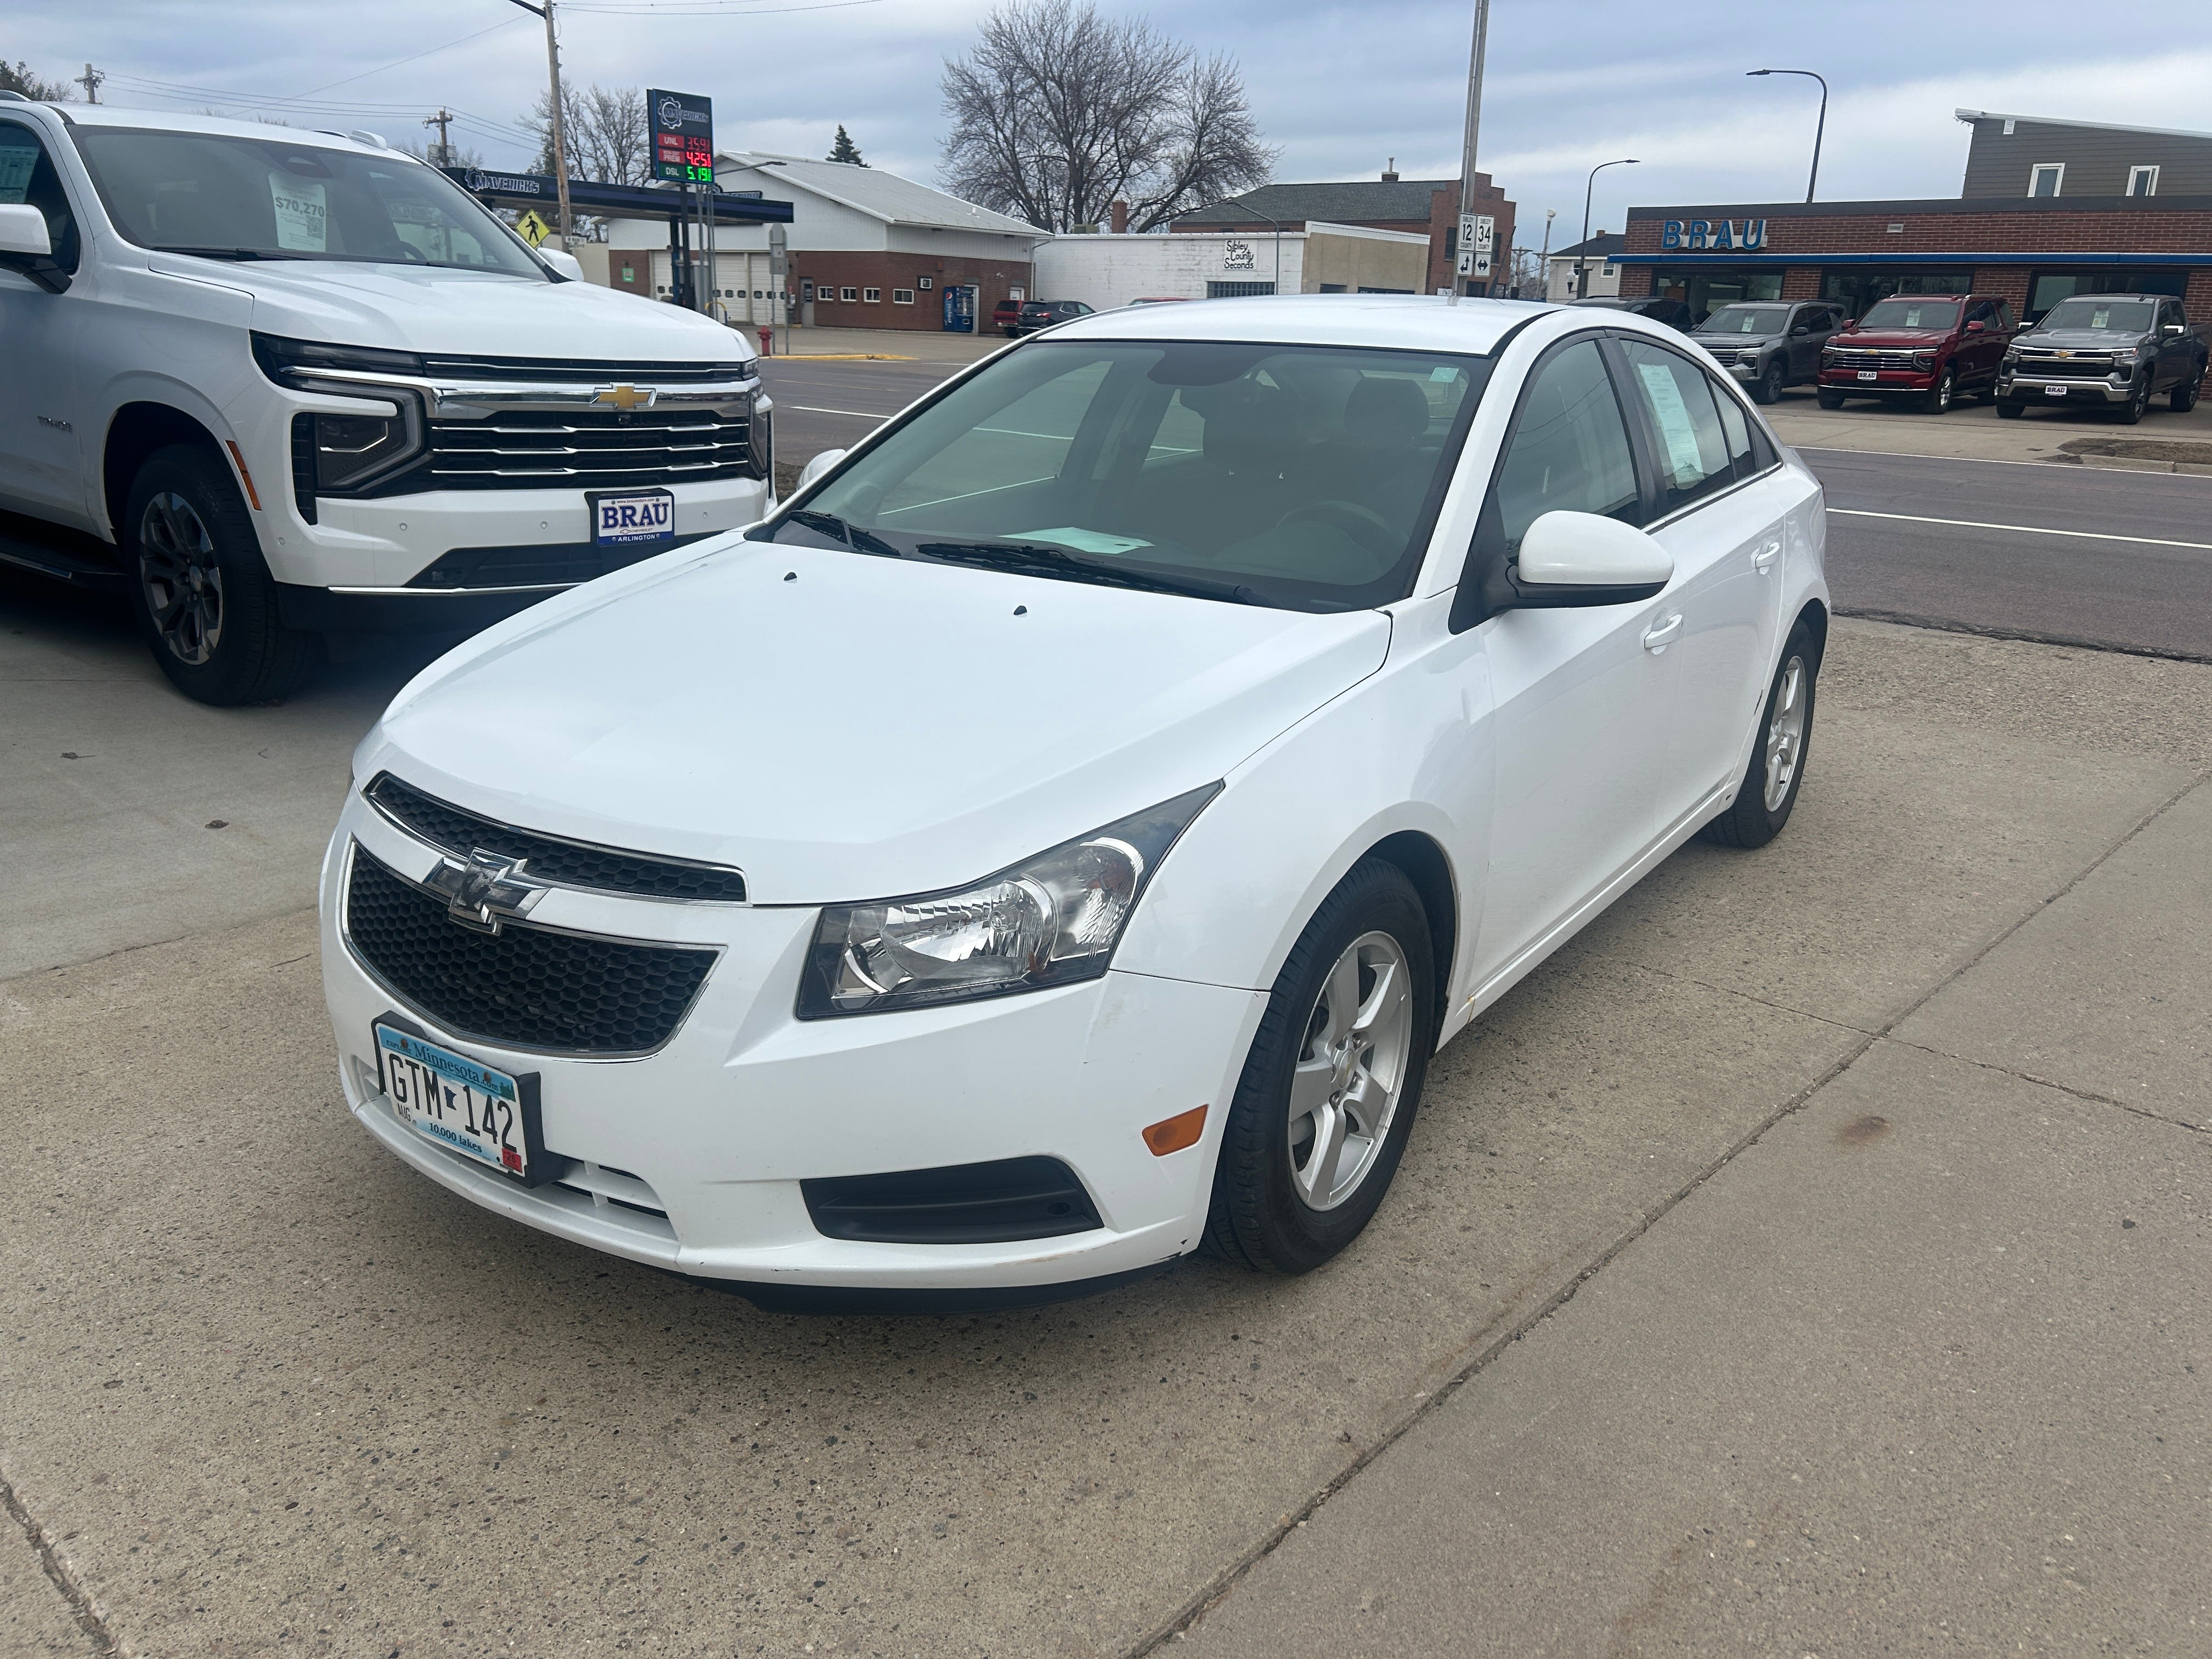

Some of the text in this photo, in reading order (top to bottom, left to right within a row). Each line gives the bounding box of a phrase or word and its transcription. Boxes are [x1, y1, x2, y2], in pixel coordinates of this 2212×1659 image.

[664, 136, 678, 145] UNL
[665, 167, 679, 176] DSL
[275, 196, 325, 218] $70,270
[1463, 224, 1472, 241] 12
[1478, 225, 1491, 243] 34
[1661, 219, 1767, 250] BRAU
[1227, 240, 1248, 253] Sibley
[1224, 257, 1254, 269] Seconds
[1231, 249, 1254, 263] County
[601, 502, 669, 529] BRAU
[618, 534, 655, 543] ARLINGTON
[388, 1053, 517, 1153] GTM 142
[397, 1103, 411, 1122] AUG
[429, 1122, 482, 1153] 10,000 lakes
[506, 1153, 516, 1163] 26
